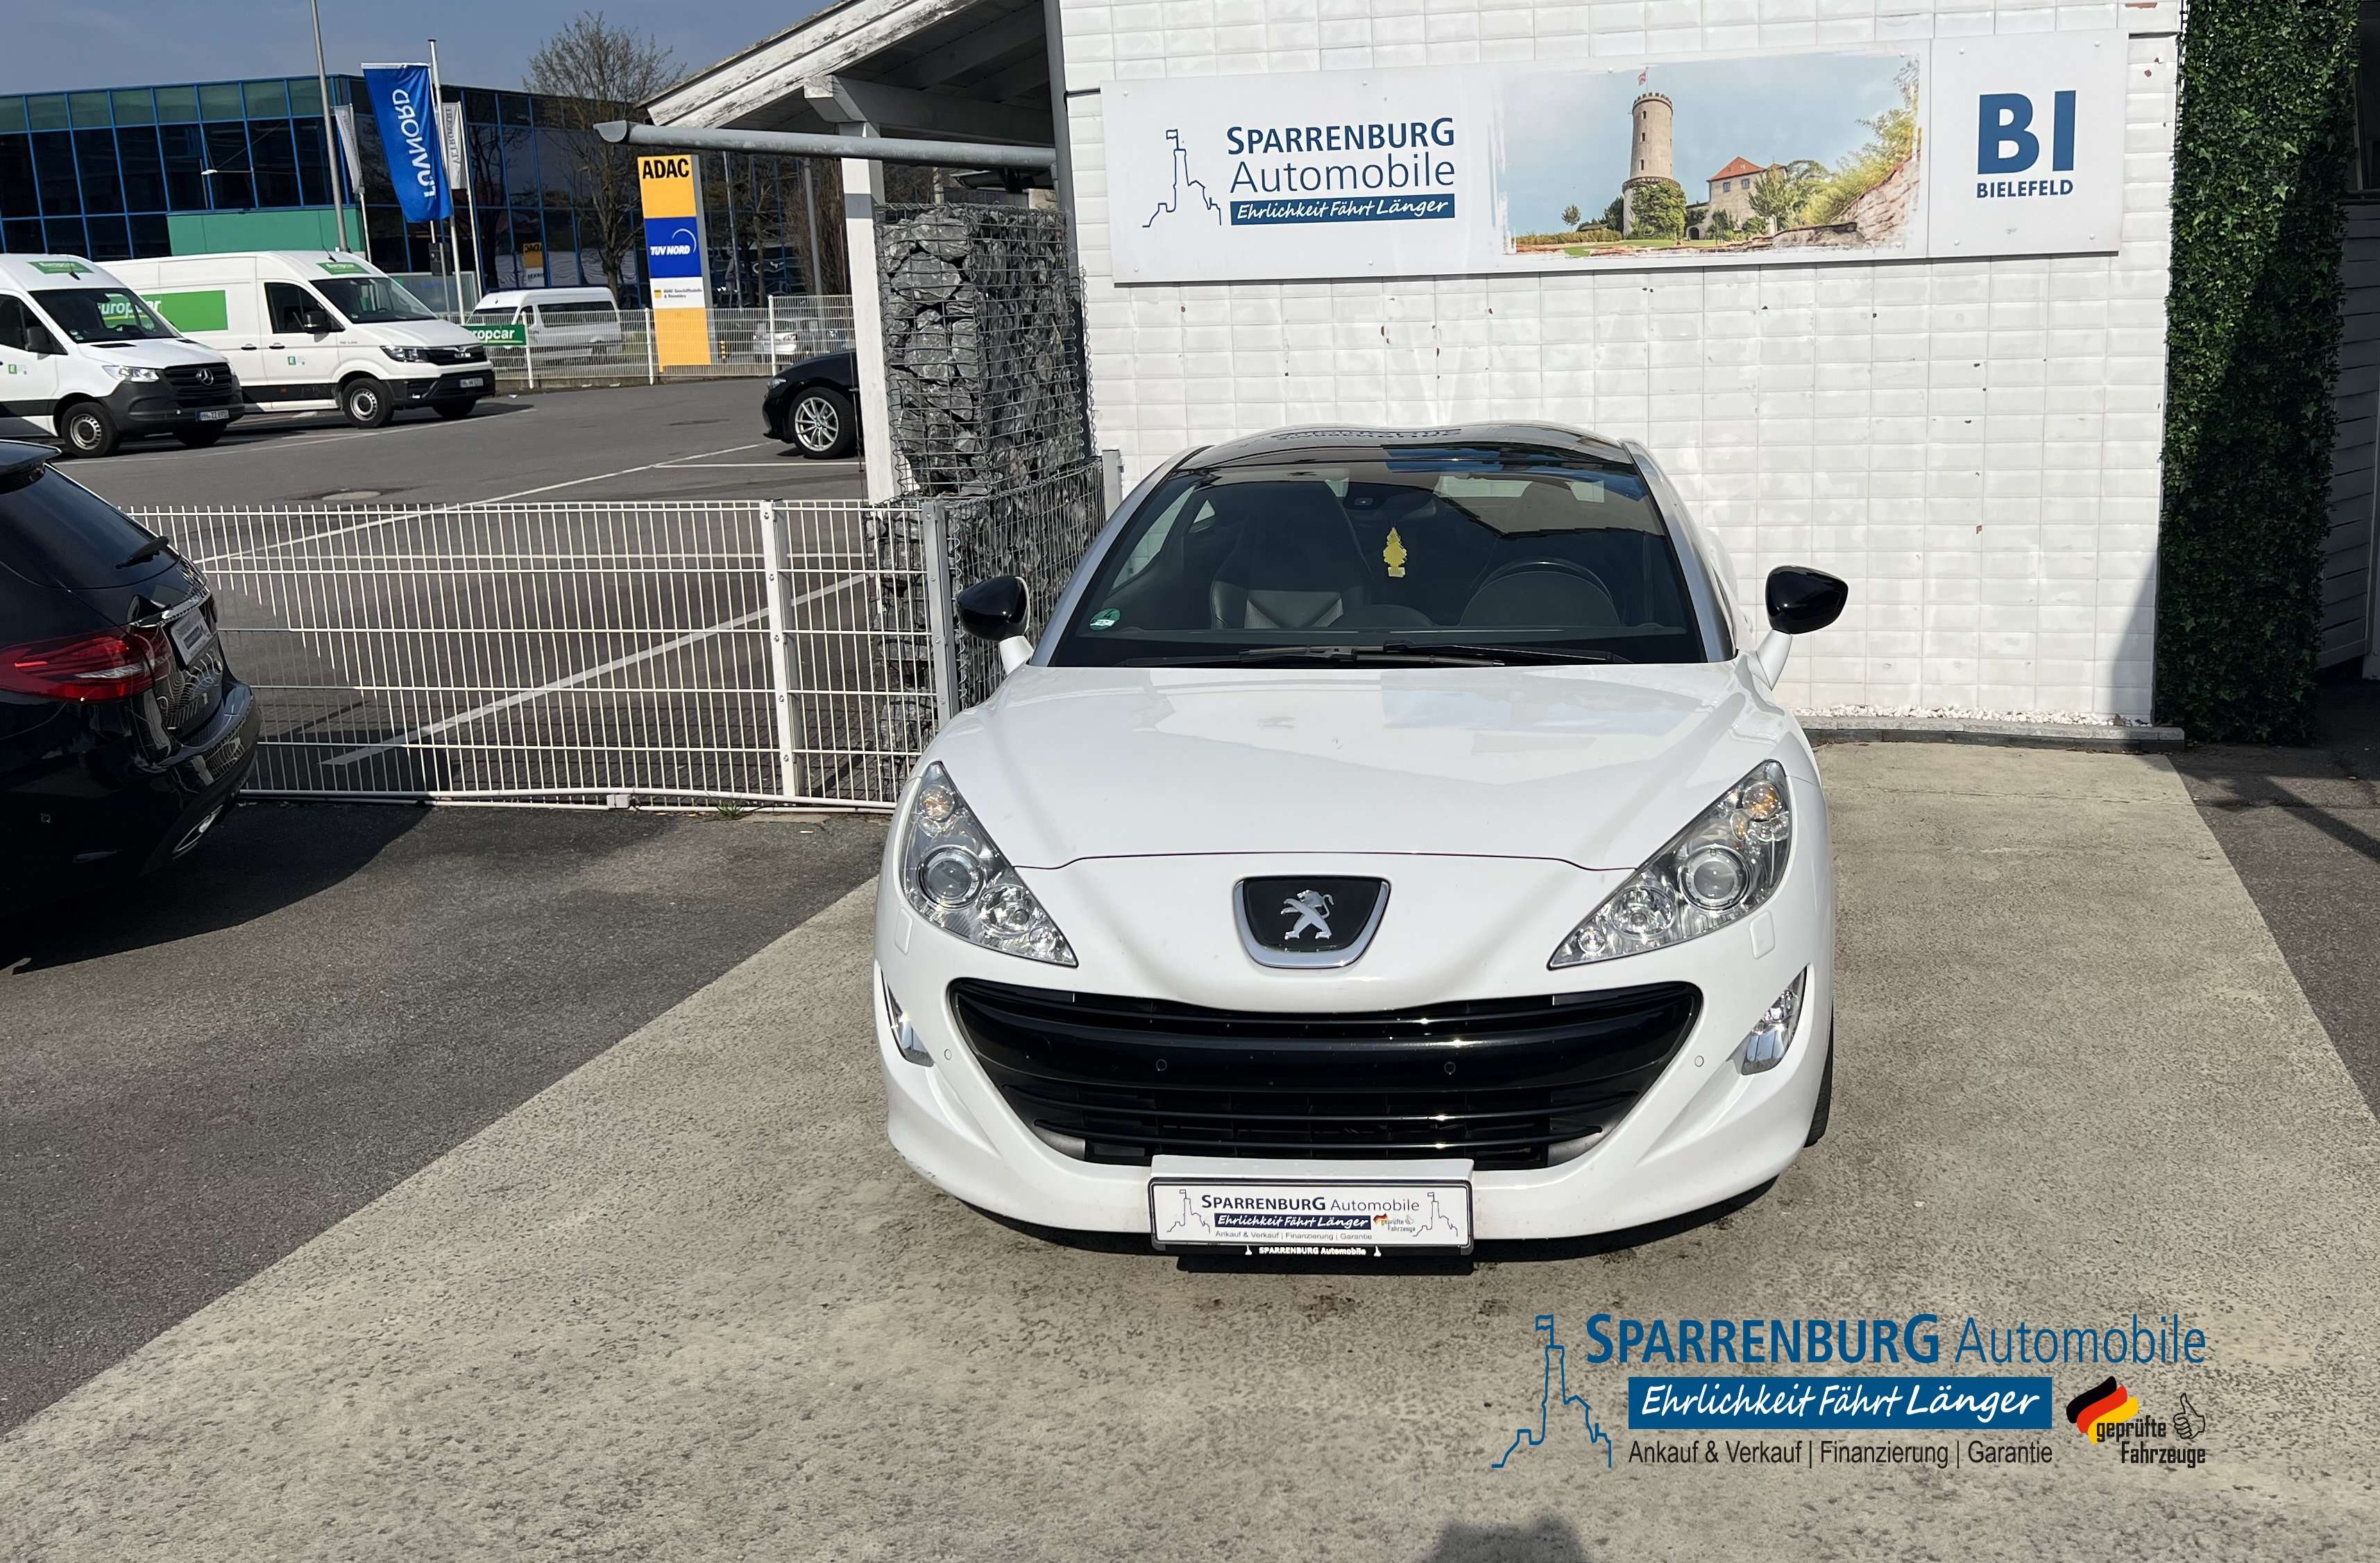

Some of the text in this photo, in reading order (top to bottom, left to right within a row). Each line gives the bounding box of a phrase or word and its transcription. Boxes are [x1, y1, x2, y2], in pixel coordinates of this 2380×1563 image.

[1227, 117, 1454, 155] SPARRENBURG
[1978, 90, 2076, 174] BI
[643, 158, 690, 179] ADAC
[1229, 151, 1455, 193] Automobile
[1976, 179, 2074, 198] BIELEFELD
[1236, 196, 1448, 220] Ehrlichkeit Fährt Länger
[1201, 1194, 1420, 1211] SPARRENBURG Automobile
[1218, 1215, 1368, 1229] Ehrlichkeit Fährt Länger
[1259, 1246, 1318, 1255] SPARRENBURG
